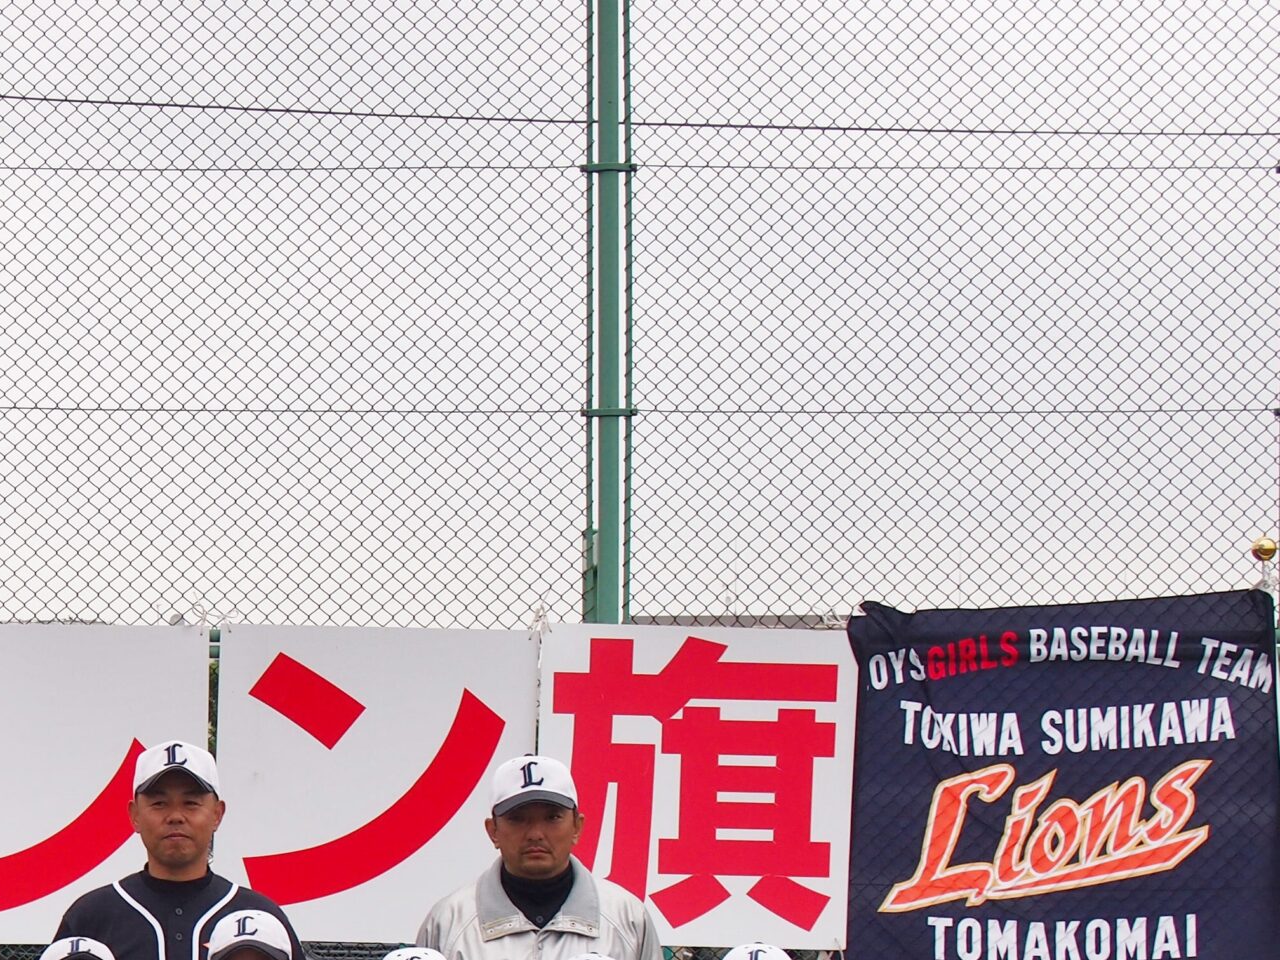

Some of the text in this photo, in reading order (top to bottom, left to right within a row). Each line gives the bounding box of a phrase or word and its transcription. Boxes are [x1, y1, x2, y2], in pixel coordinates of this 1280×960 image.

[927, 631, 1019, 680] GIRLS
[1029, 626, 1181, 669] BASEBALL
[1197, 637, 1273, 694] TEAM
[900, 697, 1236, 756] TOKIWA SUMIKAWA
[162, 743, 187, 766] L
[519, 761, 544, 788] L
[878, 760, 1212, 912] Lions
[233, 915, 258, 938] L
